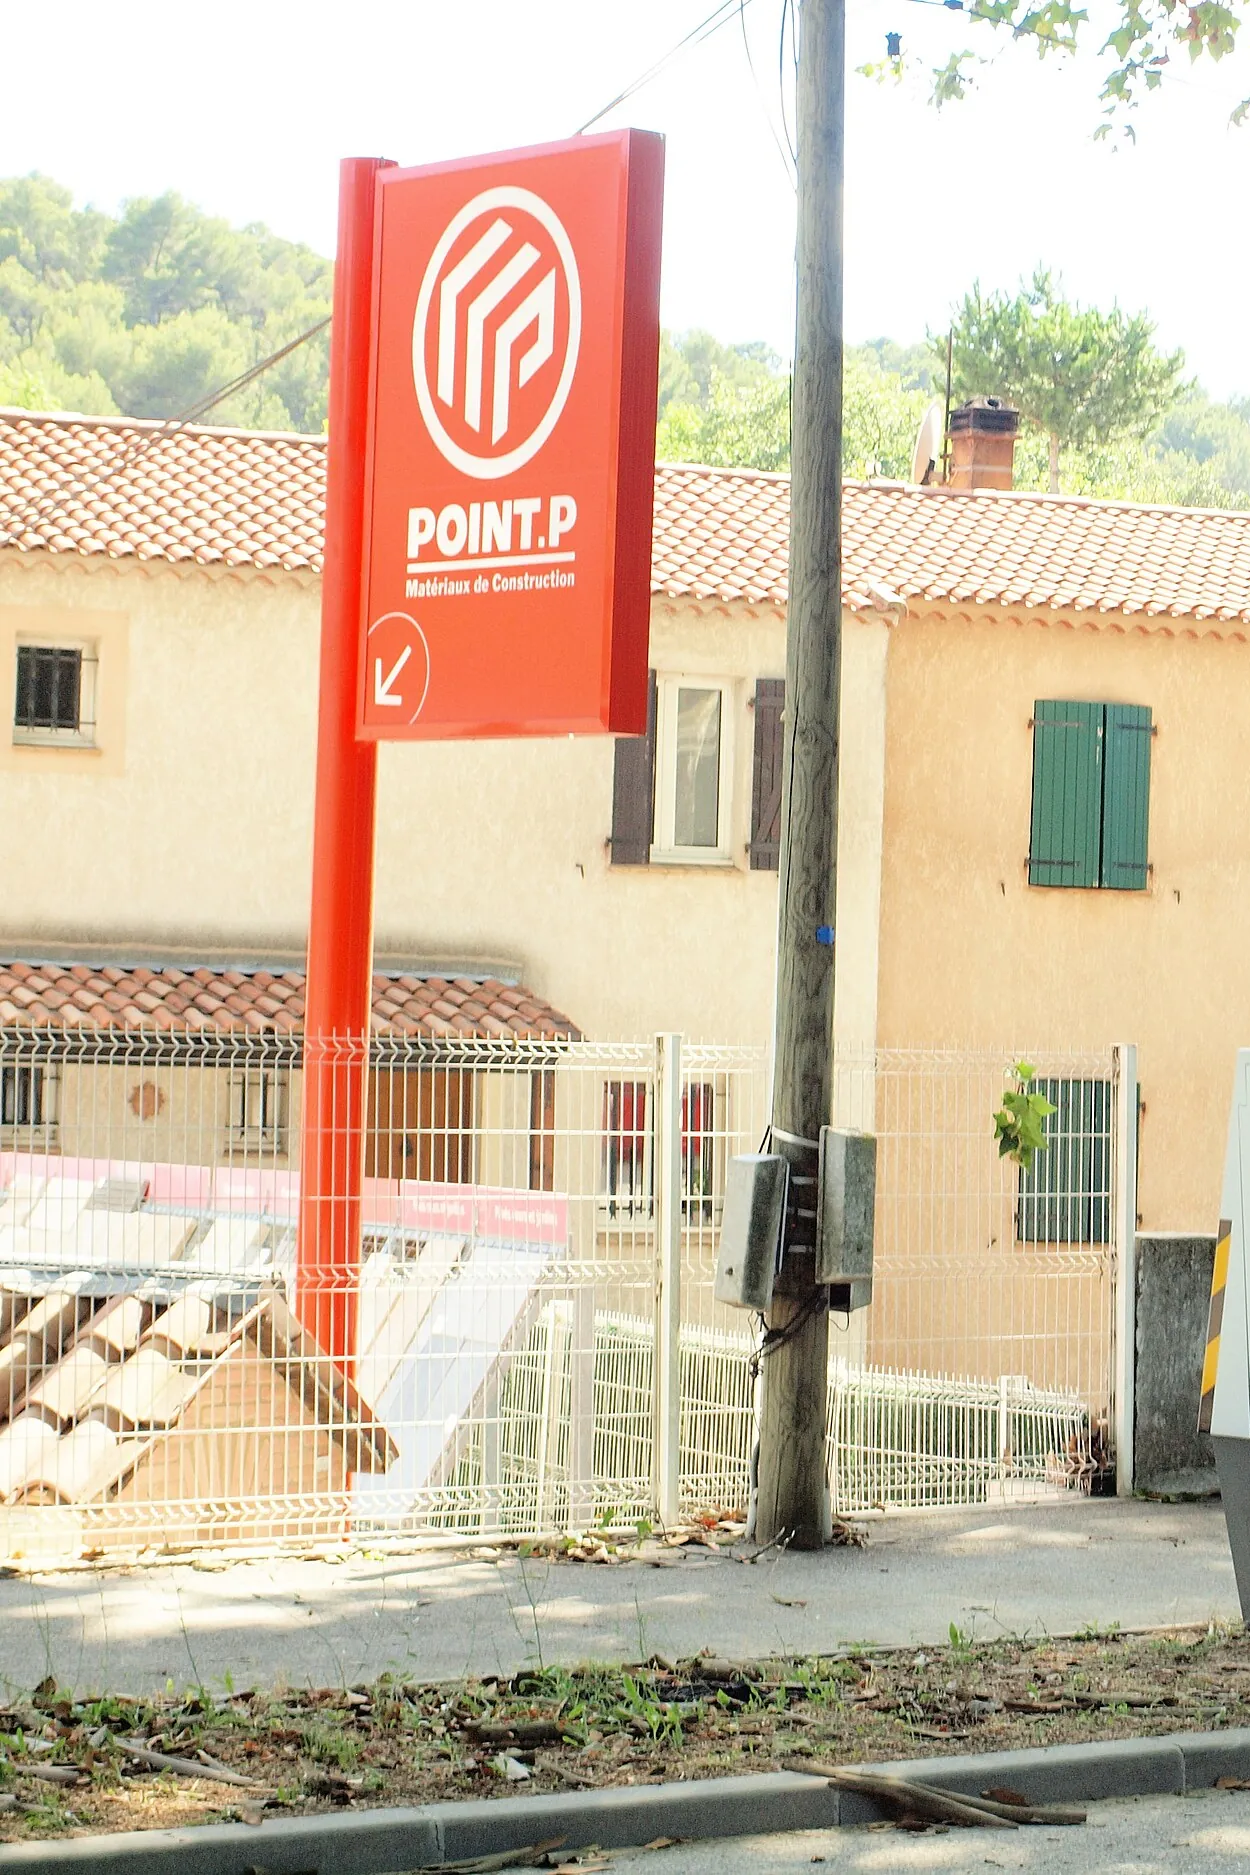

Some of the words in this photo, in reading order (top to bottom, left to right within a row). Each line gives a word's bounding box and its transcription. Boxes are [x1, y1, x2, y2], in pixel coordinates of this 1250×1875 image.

[407, 495, 578, 559] POINT.P
[405, 576, 470, 598] Matériaux
[474, 574, 490, 593] de
[492, 568, 576, 592] Construction
